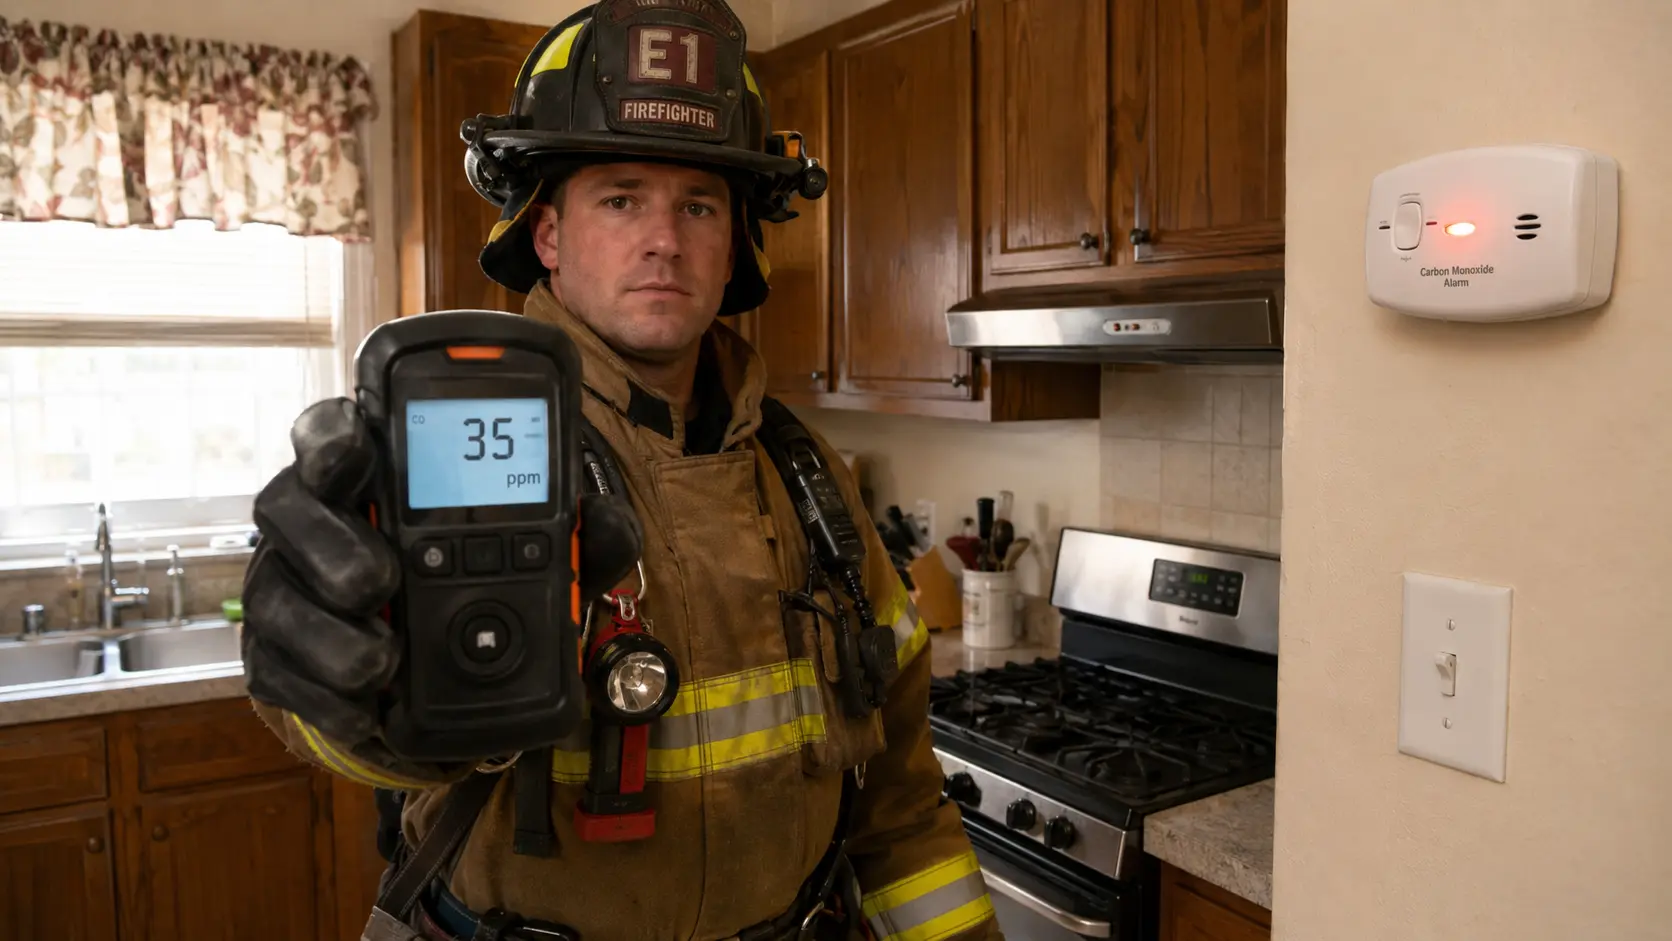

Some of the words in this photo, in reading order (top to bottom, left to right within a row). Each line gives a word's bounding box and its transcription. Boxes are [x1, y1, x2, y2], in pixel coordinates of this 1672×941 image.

[639, 29, 699, 84] E1
[624, 102, 715, 128] FIREFIGHTER
[1420, 266, 1450, 277] Carbon
[1451, 264, 1494, 275] Monoxide
[1443, 277, 1469, 288] Alarm
[463, 417, 514, 461] 35
[507, 472, 541, 488] ppm
